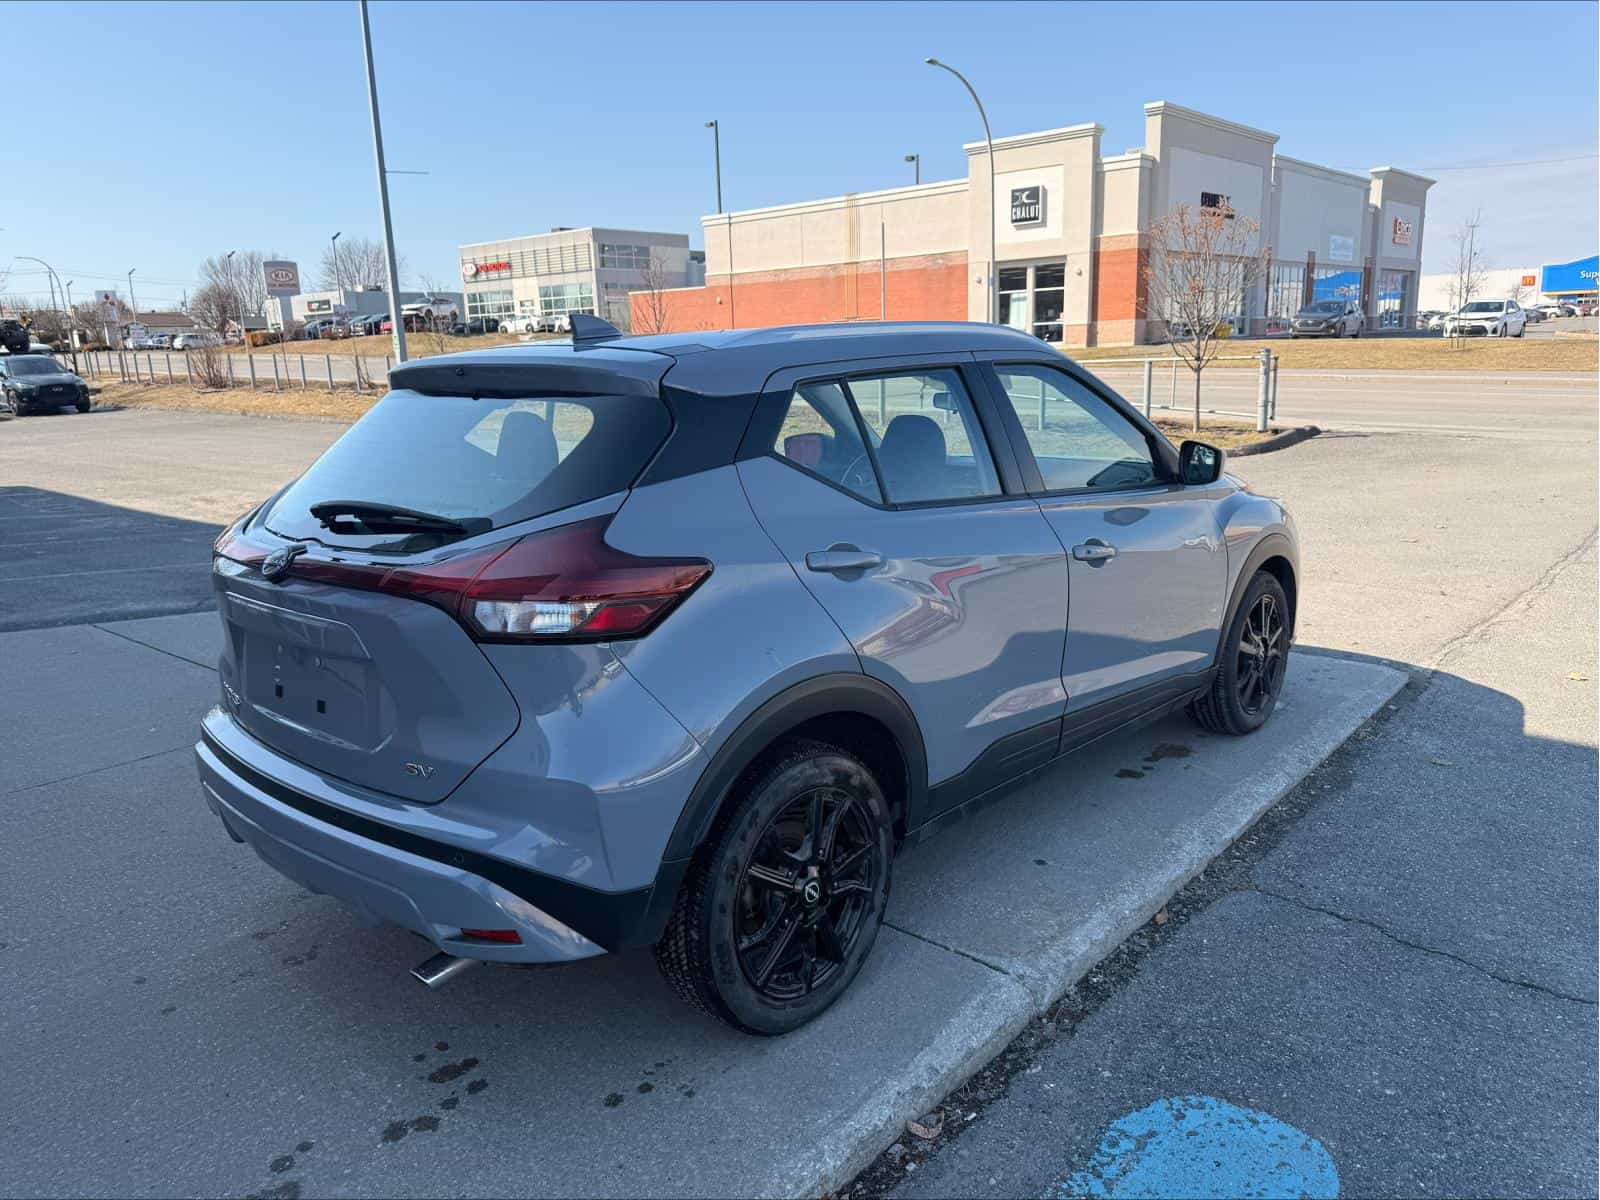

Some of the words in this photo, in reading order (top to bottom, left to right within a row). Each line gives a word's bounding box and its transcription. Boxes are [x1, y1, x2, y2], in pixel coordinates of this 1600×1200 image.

[1012, 204, 1040, 220] CHALUT
[271, 270, 294, 281] KIA
[406, 763, 434, 779] SV
